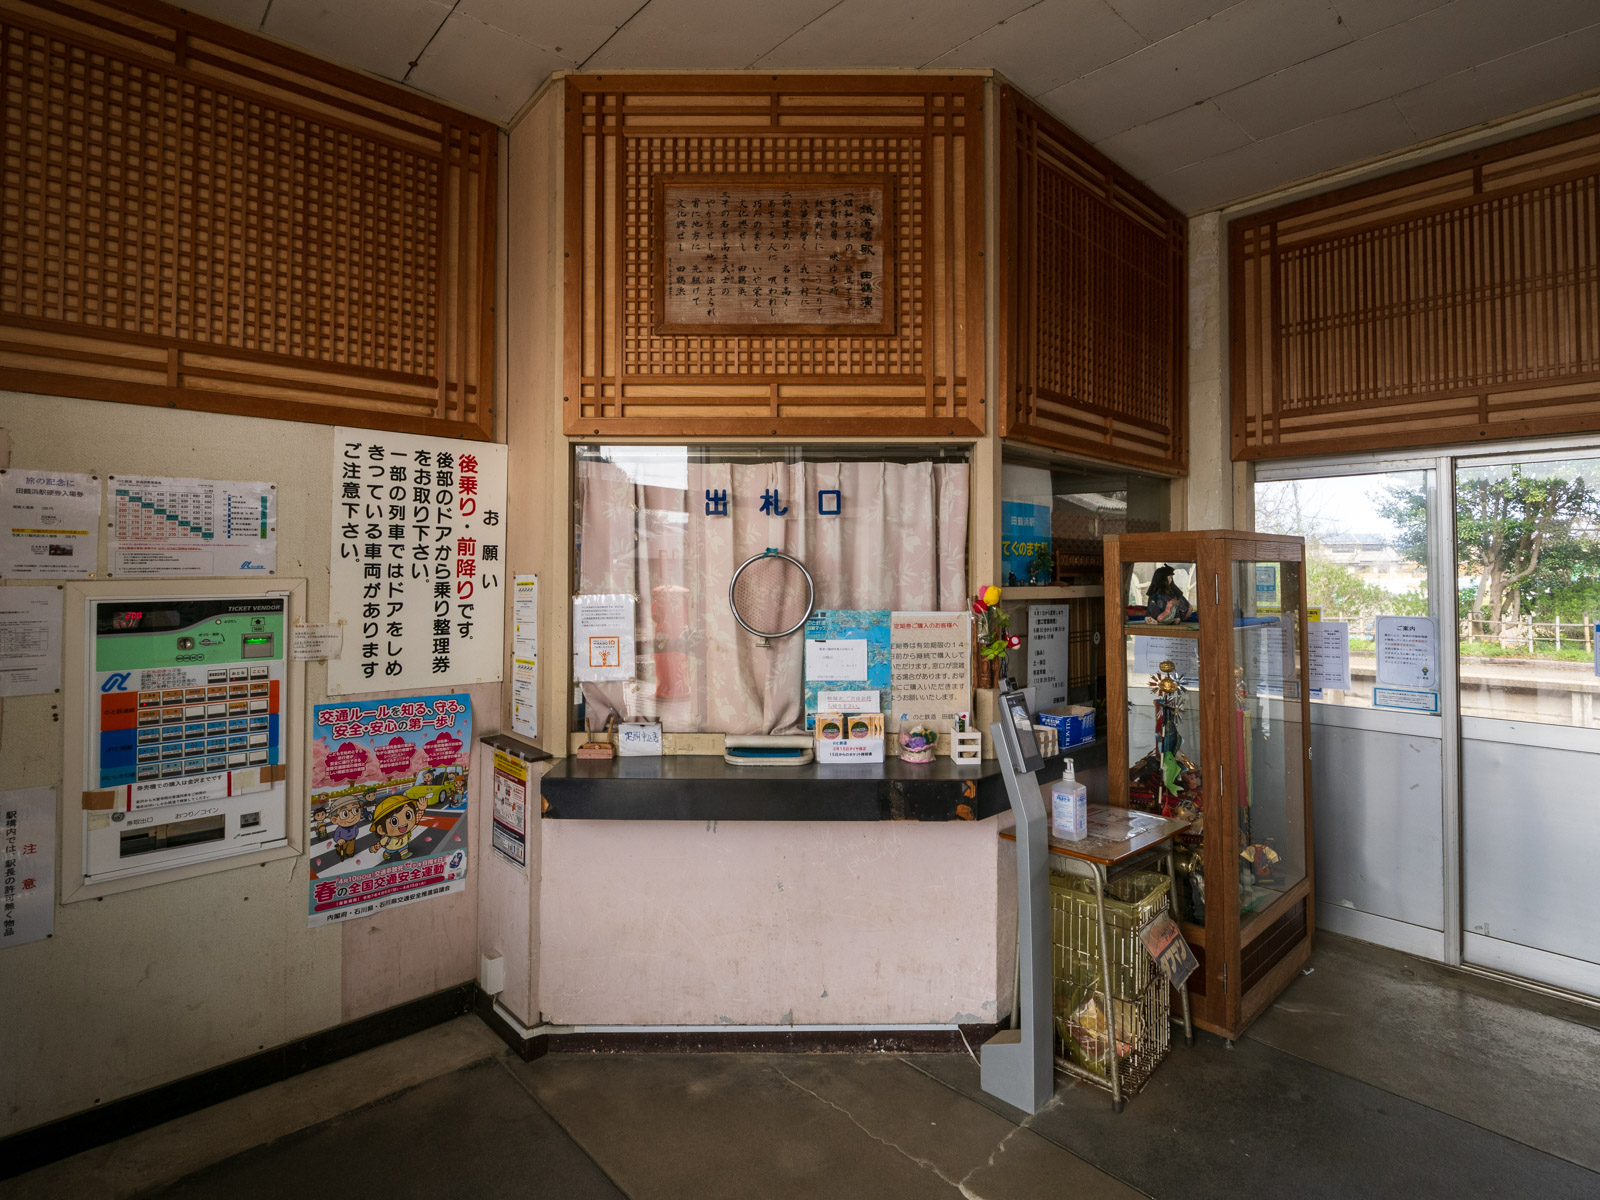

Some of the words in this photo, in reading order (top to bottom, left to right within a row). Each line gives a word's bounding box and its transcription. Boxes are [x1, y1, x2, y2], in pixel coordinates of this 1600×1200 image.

[15, 487, 84, 498] 田鶴浜駅硬券入場券
[25, 476, 75, 487] 旅の記念に
[340, 442, 362, 563] ご注意下さい。
[411, 449, 432, 584] をお取り下さい。
[705, 488, 842, 517] 出札口
[385, 452, 407, 677] 一部の列車ではドアをしめ
[432, 451, 454, 674] 後部のドアから乗り整理券
[456, 453, 478, 640] 後乗り・前降りです。
[482, 509, 499, 590] お願い
[894, 622, 959, 630] 定期券ご購入のお客様へ
[318, 699, 466, 726] 交通ルールを知る、守る。
[136, 774, 223, 792] 券売機での購入は金沢までです
[126, 816, 154, 827] 券取出口
[21, 843, 38, 891] 注意
[314, 861, 447, 904] 春の全国交通安全運動
[326, 885, 451, 921] 内閣府・石川県・石川県交通安全推進協議会
